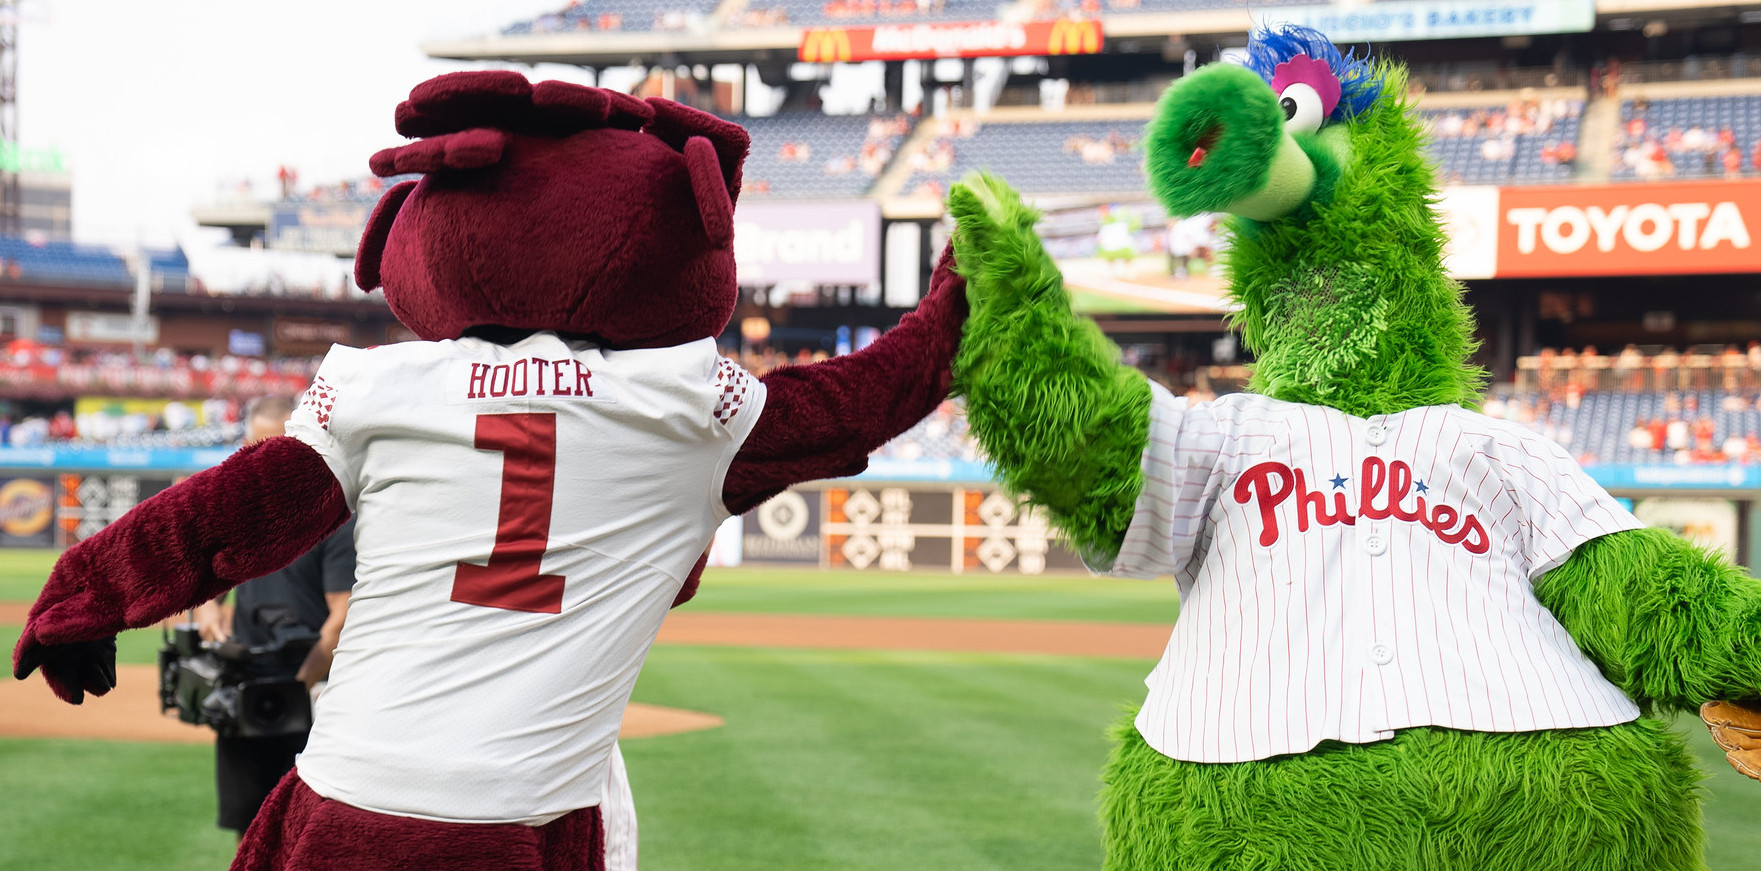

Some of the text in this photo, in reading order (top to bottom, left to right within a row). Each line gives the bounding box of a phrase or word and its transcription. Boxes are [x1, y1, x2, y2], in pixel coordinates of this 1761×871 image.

[872, 24, 1028, 53] McDonald's
[1426, 5, 1536, 28] BAKERY
[1506, 201, 1752, 256] TOYOTA
[467, 357, 594, 399] HOOTER
[450, 412, 566, 614] 1
[1233, 456, 1490, 555] Phillies
